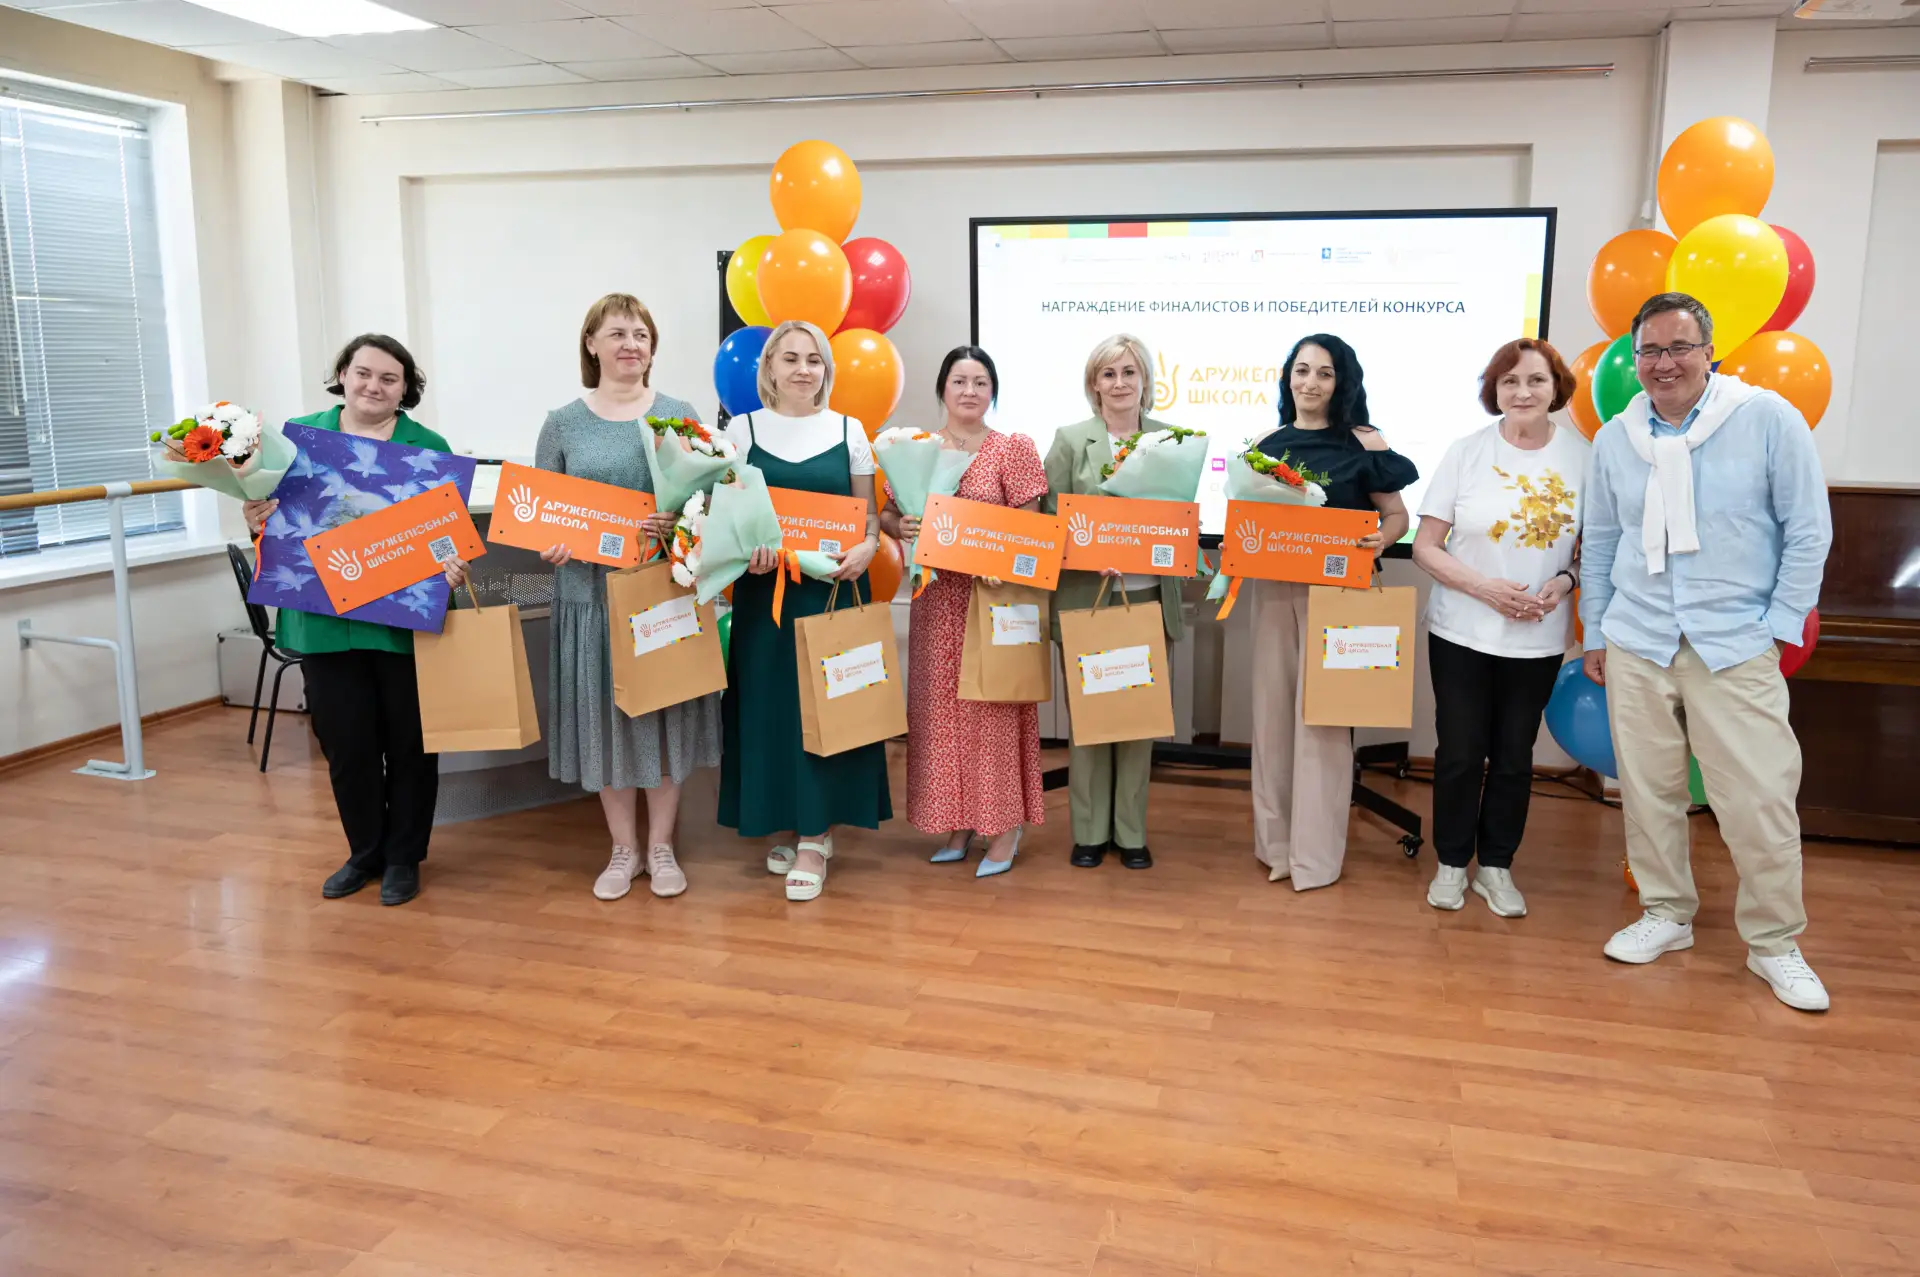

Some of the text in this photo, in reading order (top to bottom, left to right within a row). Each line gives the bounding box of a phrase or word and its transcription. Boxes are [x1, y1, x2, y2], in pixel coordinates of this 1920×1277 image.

[1041, 298, 1466, 315] НАГРАЖДЕНИЕ ФИНАЛИСТОВ И ПОБЕДИТЕЛЕЙ КОНКУРСА
[1189, 366, 1283, 383] ДРУЖЕЛ
[1187, 388, 1268, 405] ШКОЛА
[540, 511, 589, 531] ШКОЛА
[776, 514, 856, 533] РУЖЕЛЮБНАЯ
[1098, 522, 1190, 537] ДРУЖЕЛЮБНАЯ
[363, 511, 459, 557] ДРУЖЕЛЮБНАЯ
[781, 528, 808, 539] ОЛА
[963, 526, 1055, 551] ДРУЖЕЛЮБНАЯ
[1097, 534, 1141, 546] ШКОЛА
[1268, 530, 1362, 547] ДРУЖЕЛЮБНА
[961, 538, 1005, 553] ШКОЛА
[1267, 541, 1313, 555] ШКОЛА
[366, 544, 416, 569] ШКОЛА
